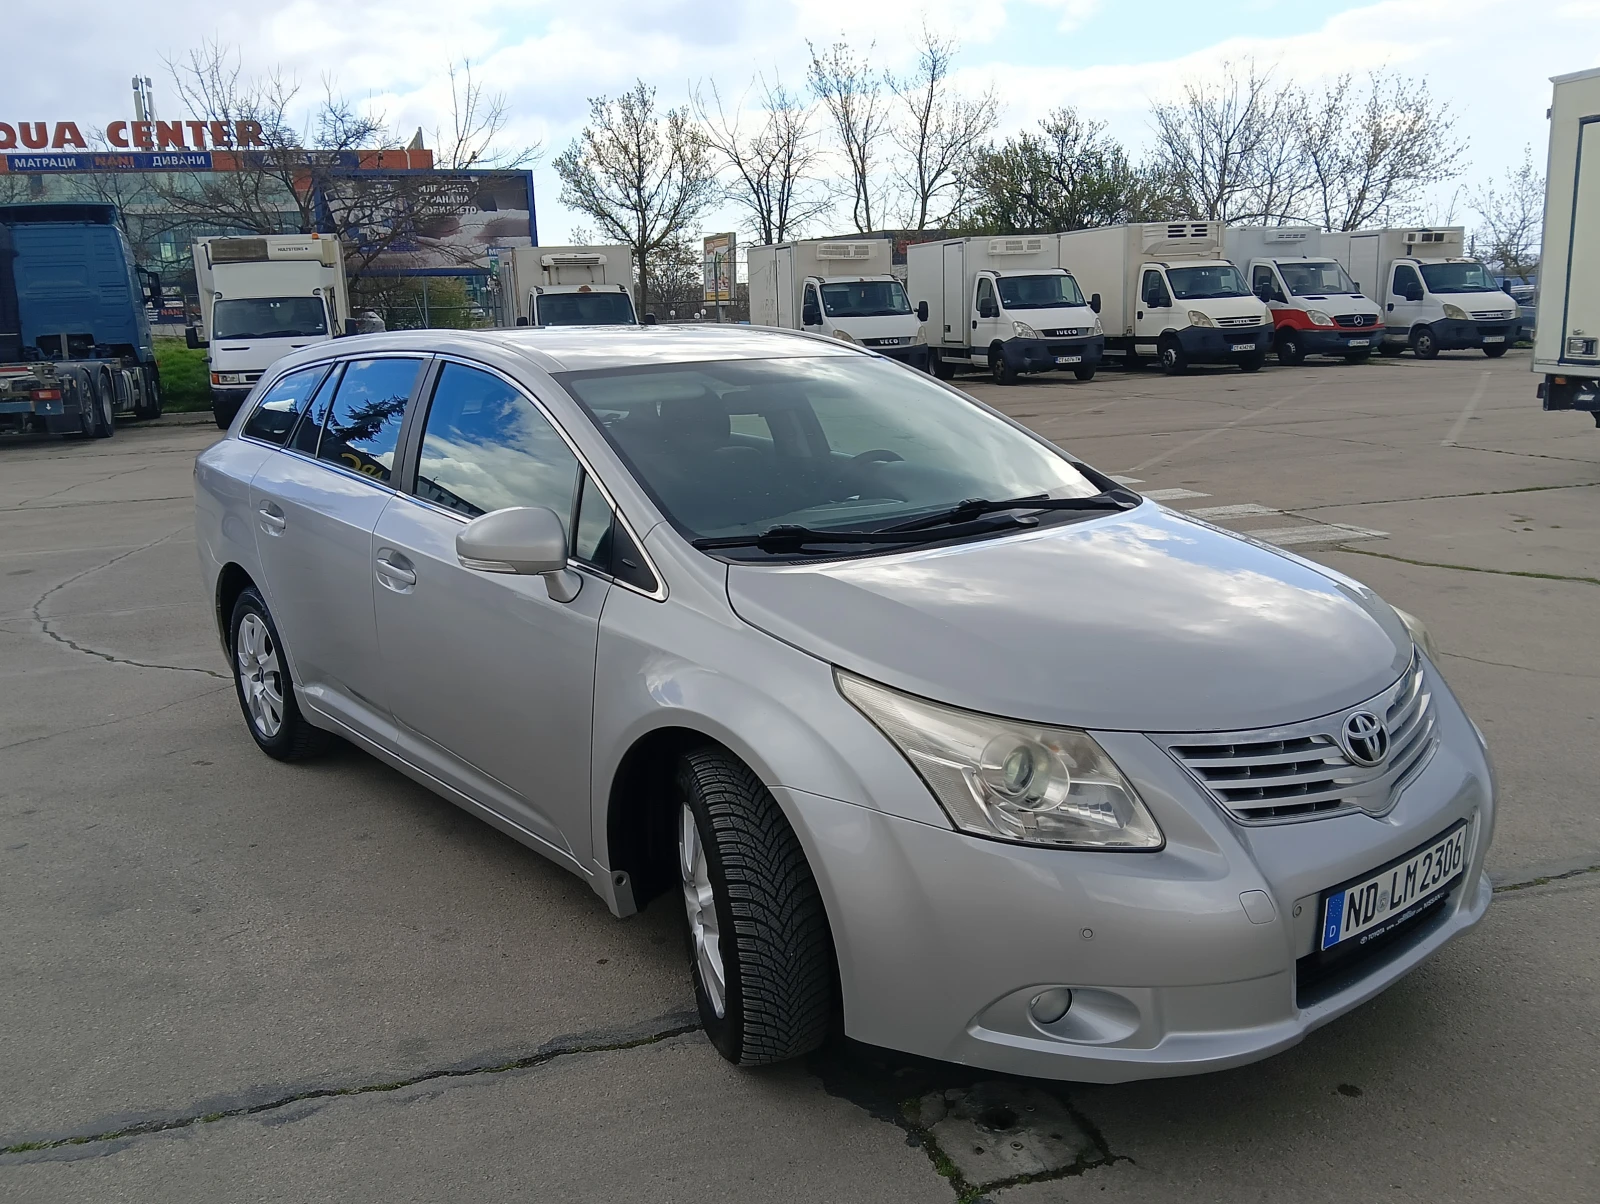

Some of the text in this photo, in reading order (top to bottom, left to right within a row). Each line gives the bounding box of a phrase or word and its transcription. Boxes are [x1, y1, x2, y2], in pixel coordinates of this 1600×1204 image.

[107, 120, 264, 148] CENTER
[14, 157, 77, 168] МАТРАЦИ
[152, 155, 206, 167] ДИВАНИ
[1345, 882, 1379, 932] ND
[1389, 860, 1418, 910] LM
[1420, 832, 1462, 893] 2306
[1329, 925, 1336, 937] D
[1368, 927, 1385, 940] TOYOTA
